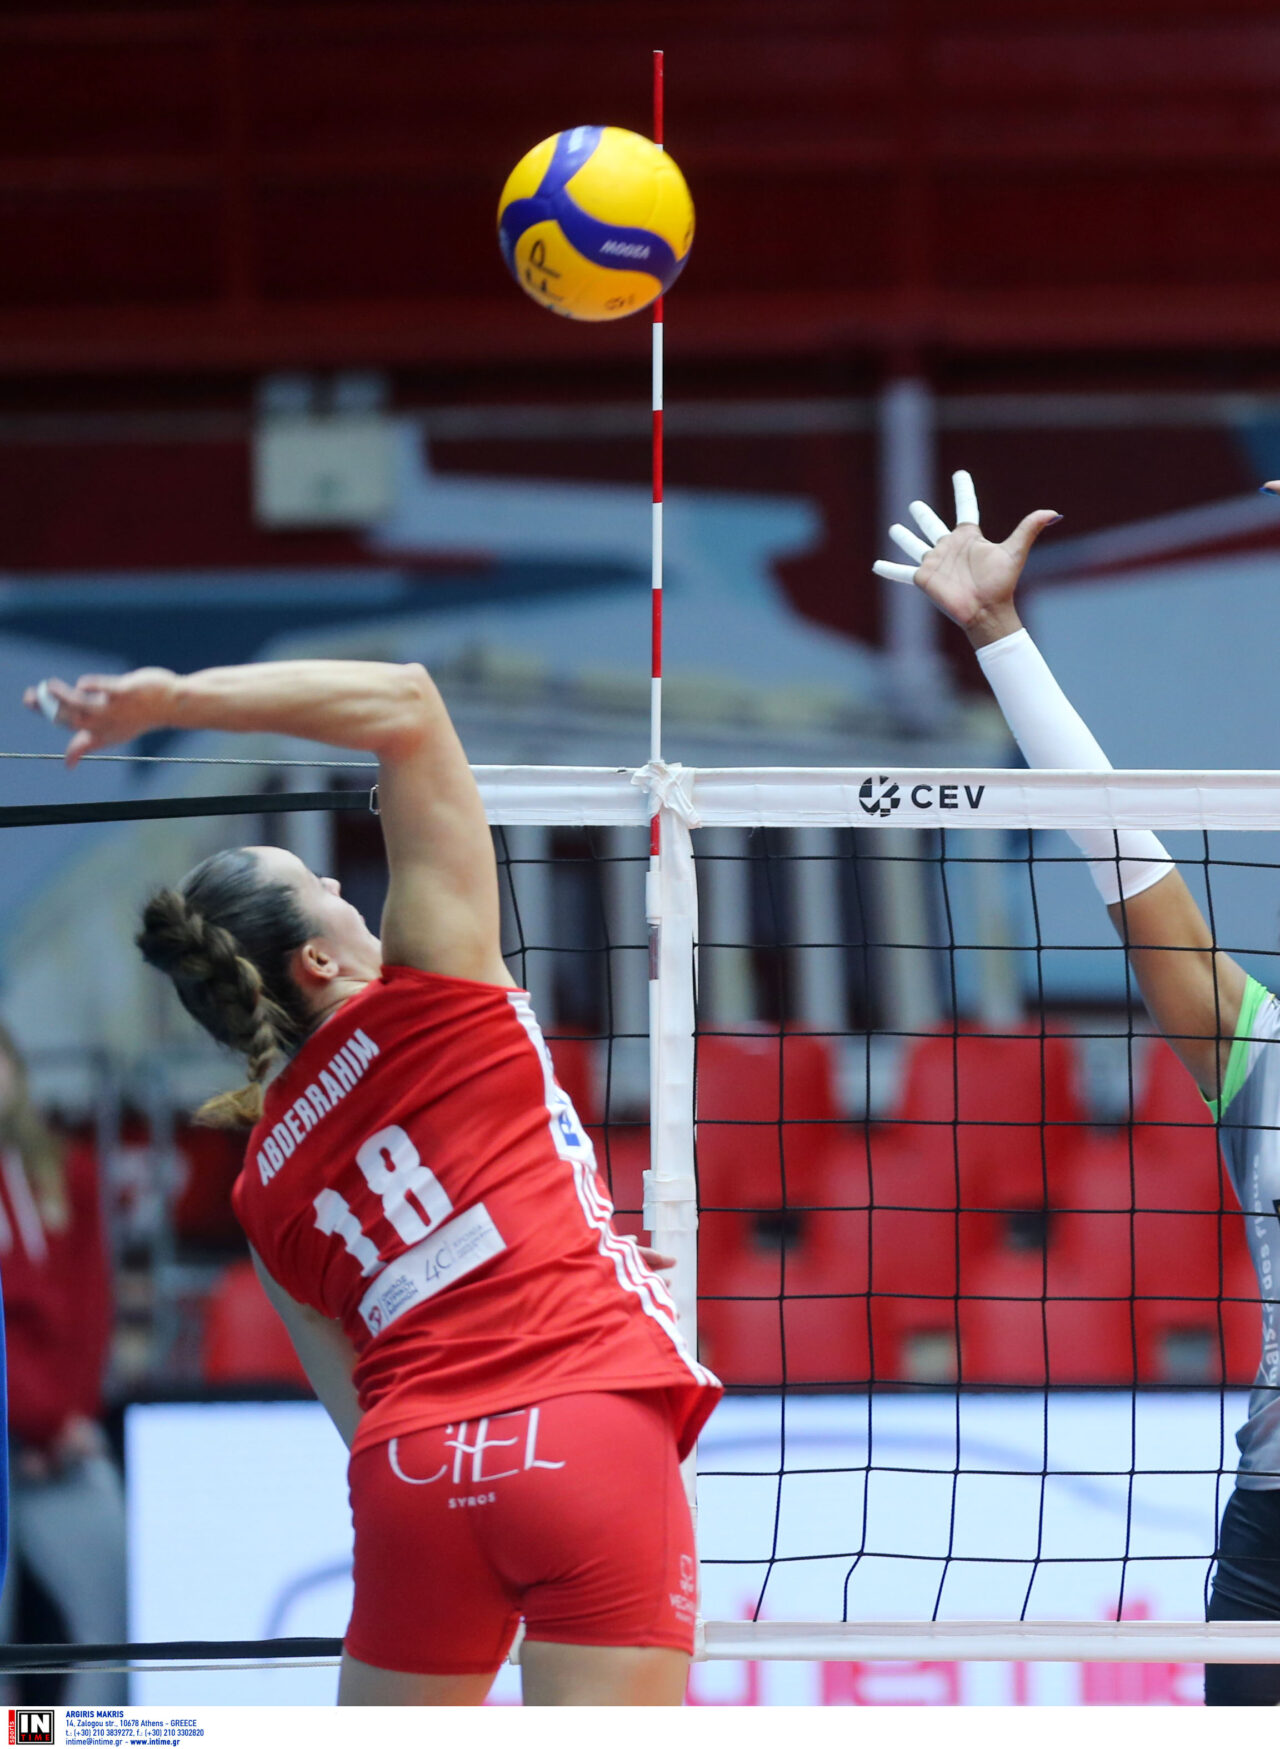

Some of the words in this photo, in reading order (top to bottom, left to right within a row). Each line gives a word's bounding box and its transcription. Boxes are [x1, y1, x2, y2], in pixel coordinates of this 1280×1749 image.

[911, 784, 985, 809] CEV
[256, 1028, 380, 1186] ABDERRAHIM
[313, 1125, 454, 1278] 18
[1259, 1243, 1273, 1290] des
[447, 1492, 497, 1509] SYROS
